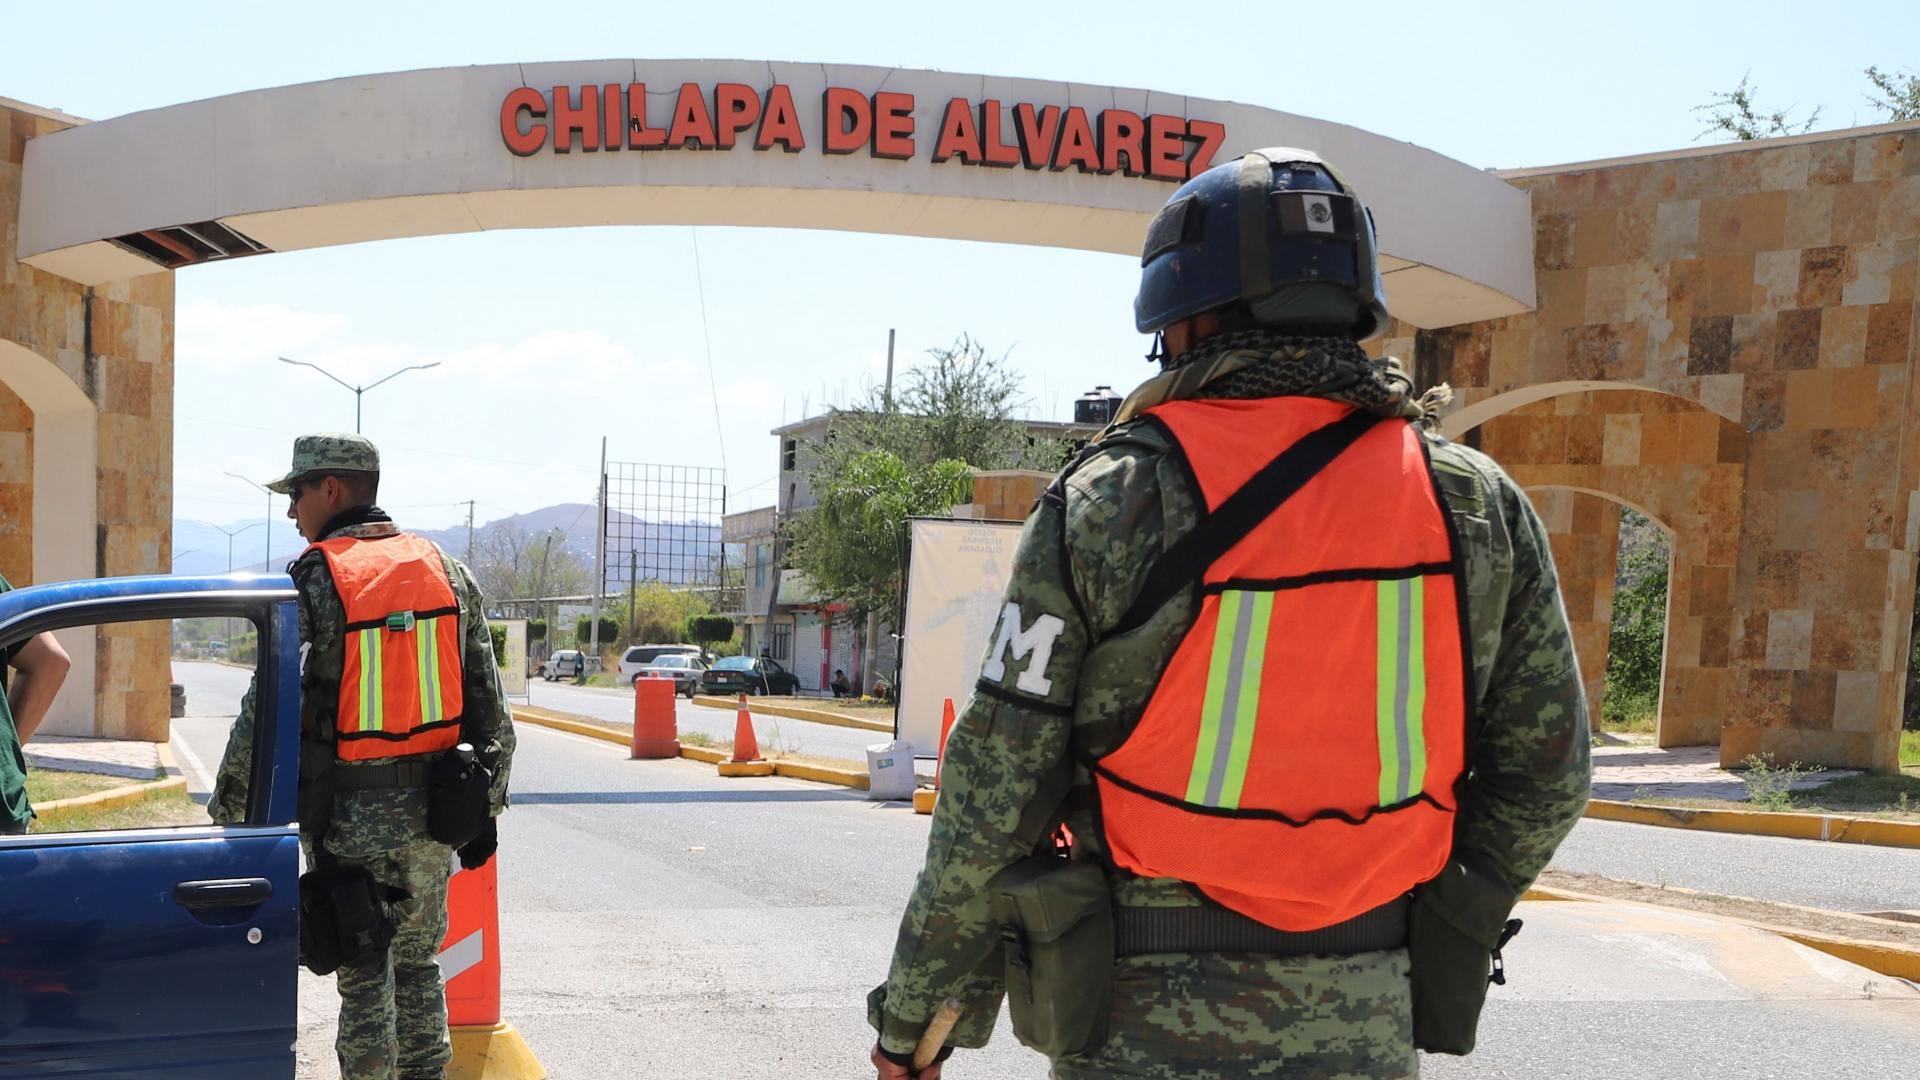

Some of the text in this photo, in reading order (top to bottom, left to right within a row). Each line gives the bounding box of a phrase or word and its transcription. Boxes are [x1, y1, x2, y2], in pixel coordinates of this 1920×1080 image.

[501, 83, 1226, 182] CHILAPA DE ALVAREZ
[981, 602, 1066, 696] M
